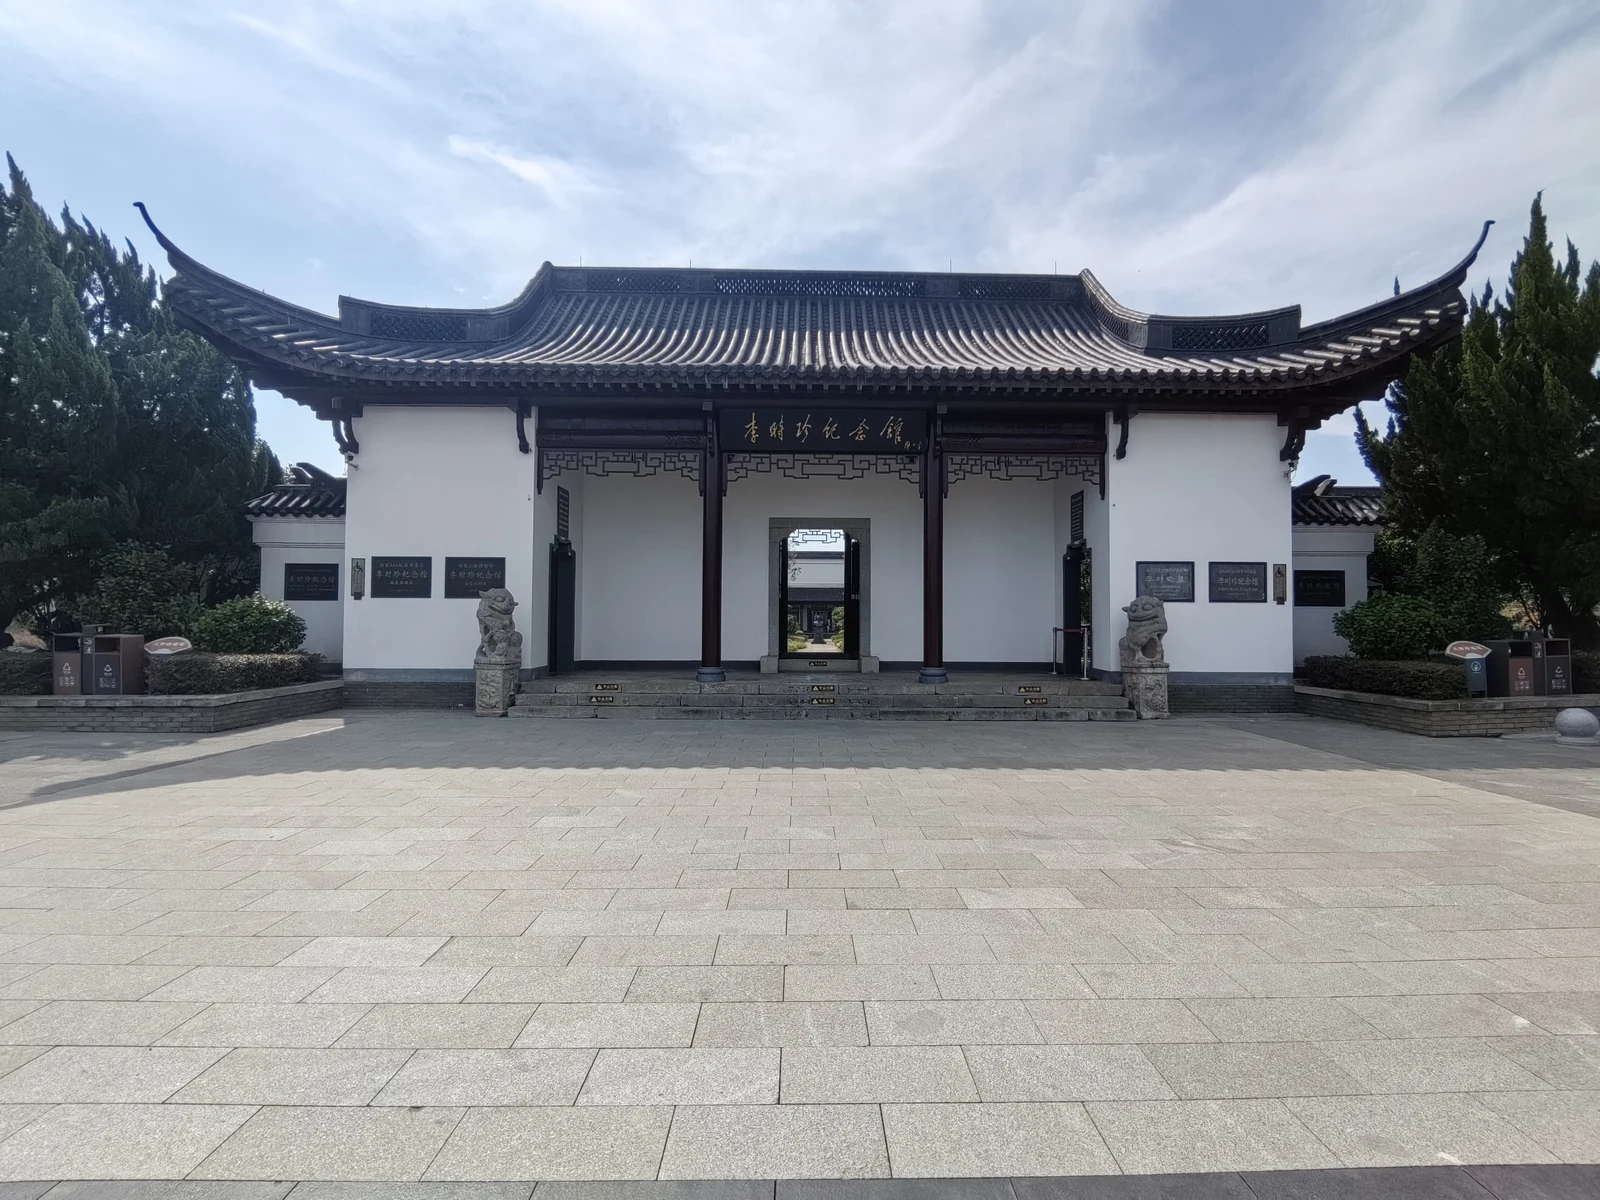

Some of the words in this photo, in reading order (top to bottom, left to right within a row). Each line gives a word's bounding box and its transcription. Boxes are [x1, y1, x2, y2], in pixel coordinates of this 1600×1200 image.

[375, 569, 429, 579] 李时珍纪念馆
[449, 569, 502, 580] 李时珍纪念馆
[1216, 576, 1260, 586] 李时珍纪念馆
